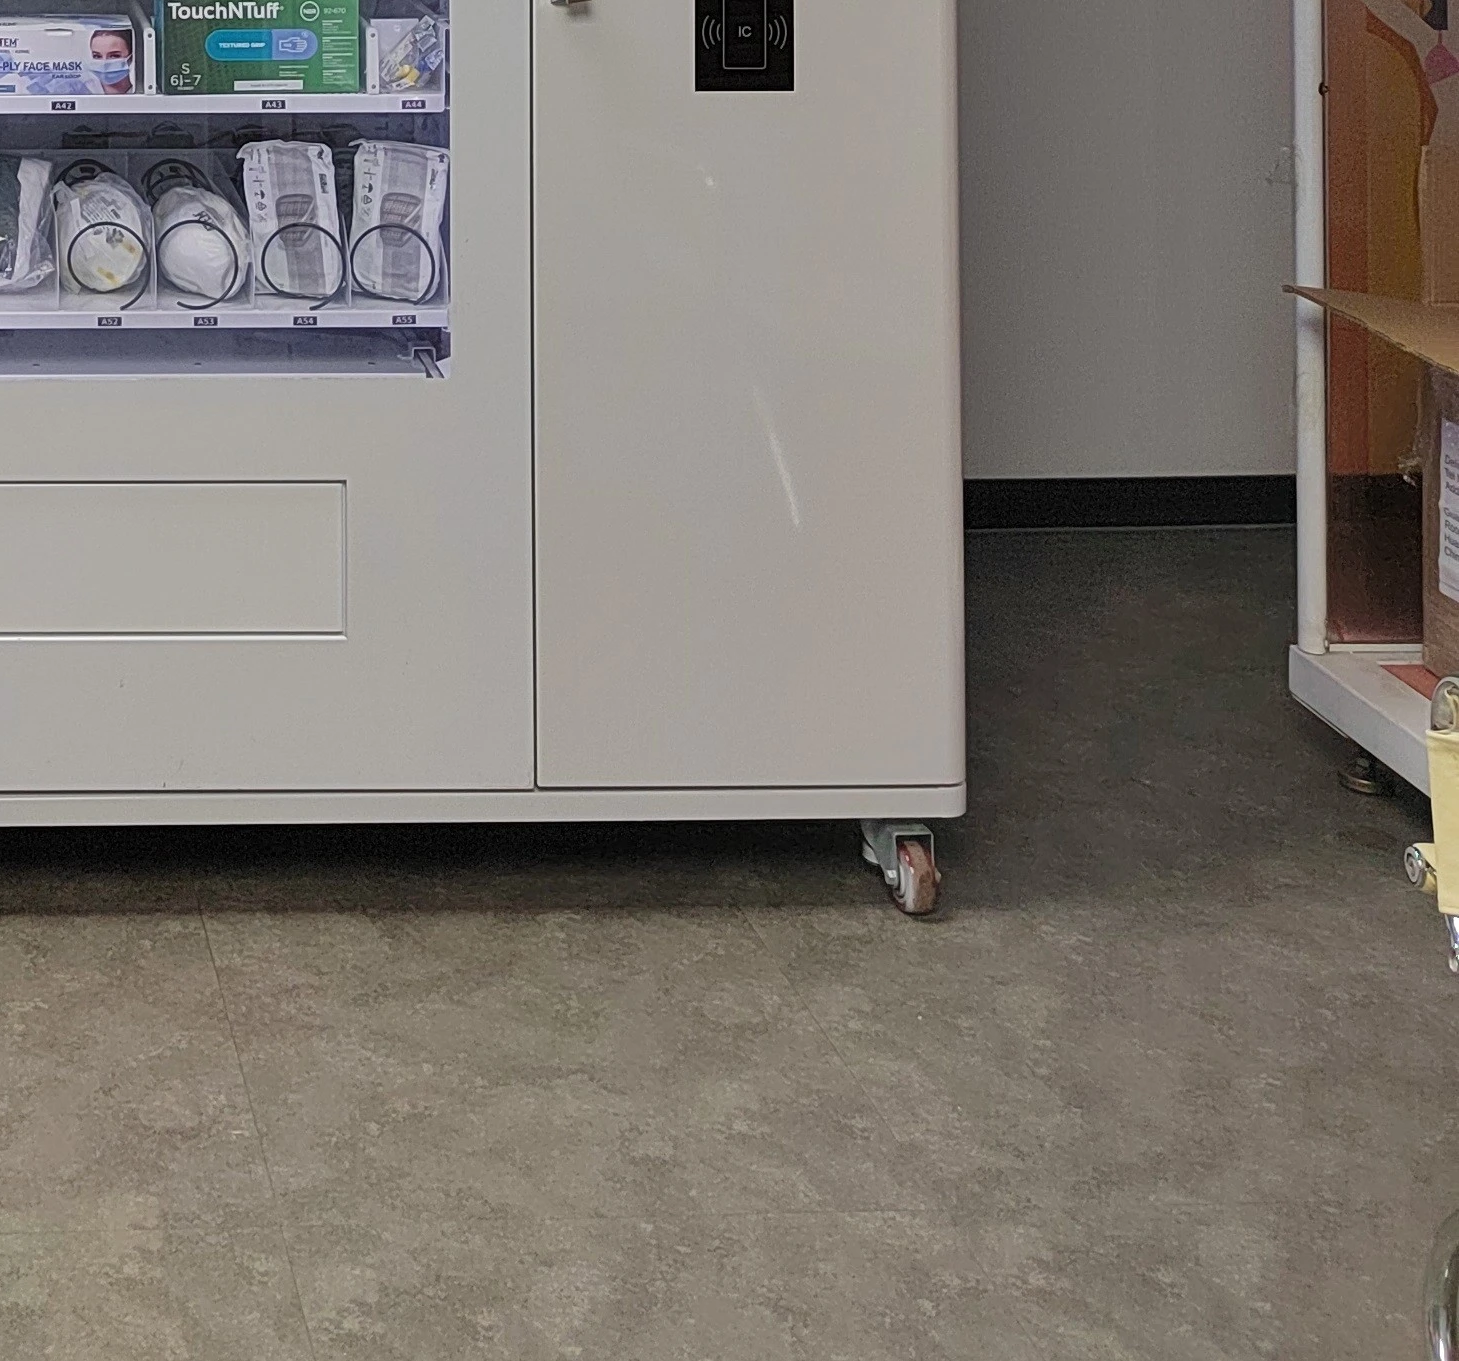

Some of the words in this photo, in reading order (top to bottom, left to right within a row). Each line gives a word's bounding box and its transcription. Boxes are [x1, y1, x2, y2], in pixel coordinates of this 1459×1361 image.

[167, 1, 281, 20] TouchNTuff
[738, 25, 752, 38] IC
[23, 61, 51, 71] FACE
[52, 61, 83, 71] MASK
[181, 62, 191, 75] S
